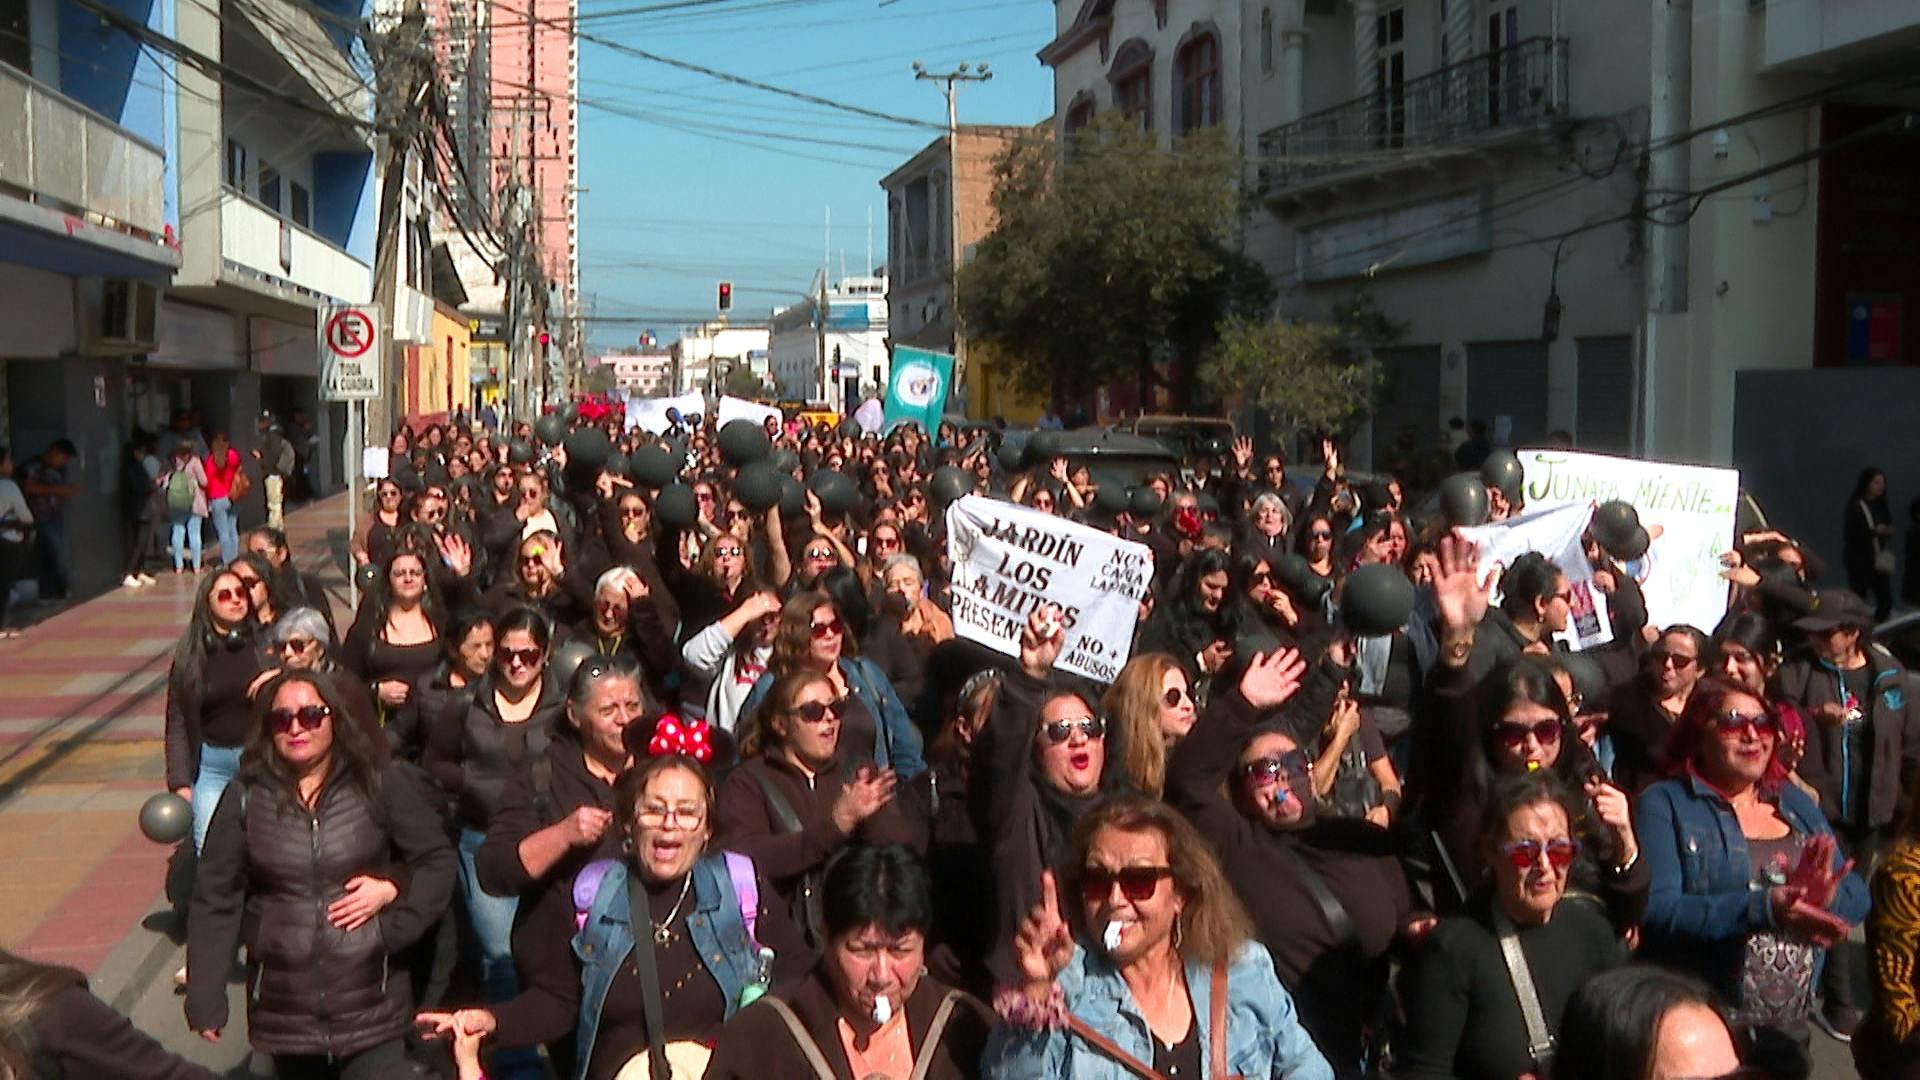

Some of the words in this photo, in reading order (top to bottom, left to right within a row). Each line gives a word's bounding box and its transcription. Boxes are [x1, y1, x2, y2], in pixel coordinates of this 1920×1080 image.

[983, 517, 1084, 568] JARDÍN
[996, 551, 1052, 590] LOS
[950, 561, 1080, 629] LLAMITS
[952, 591, 1024, 644] PRESEN
[1065, 650, 1116, 680] ABUSOS
[1077, 635, 1104, 655] NO
